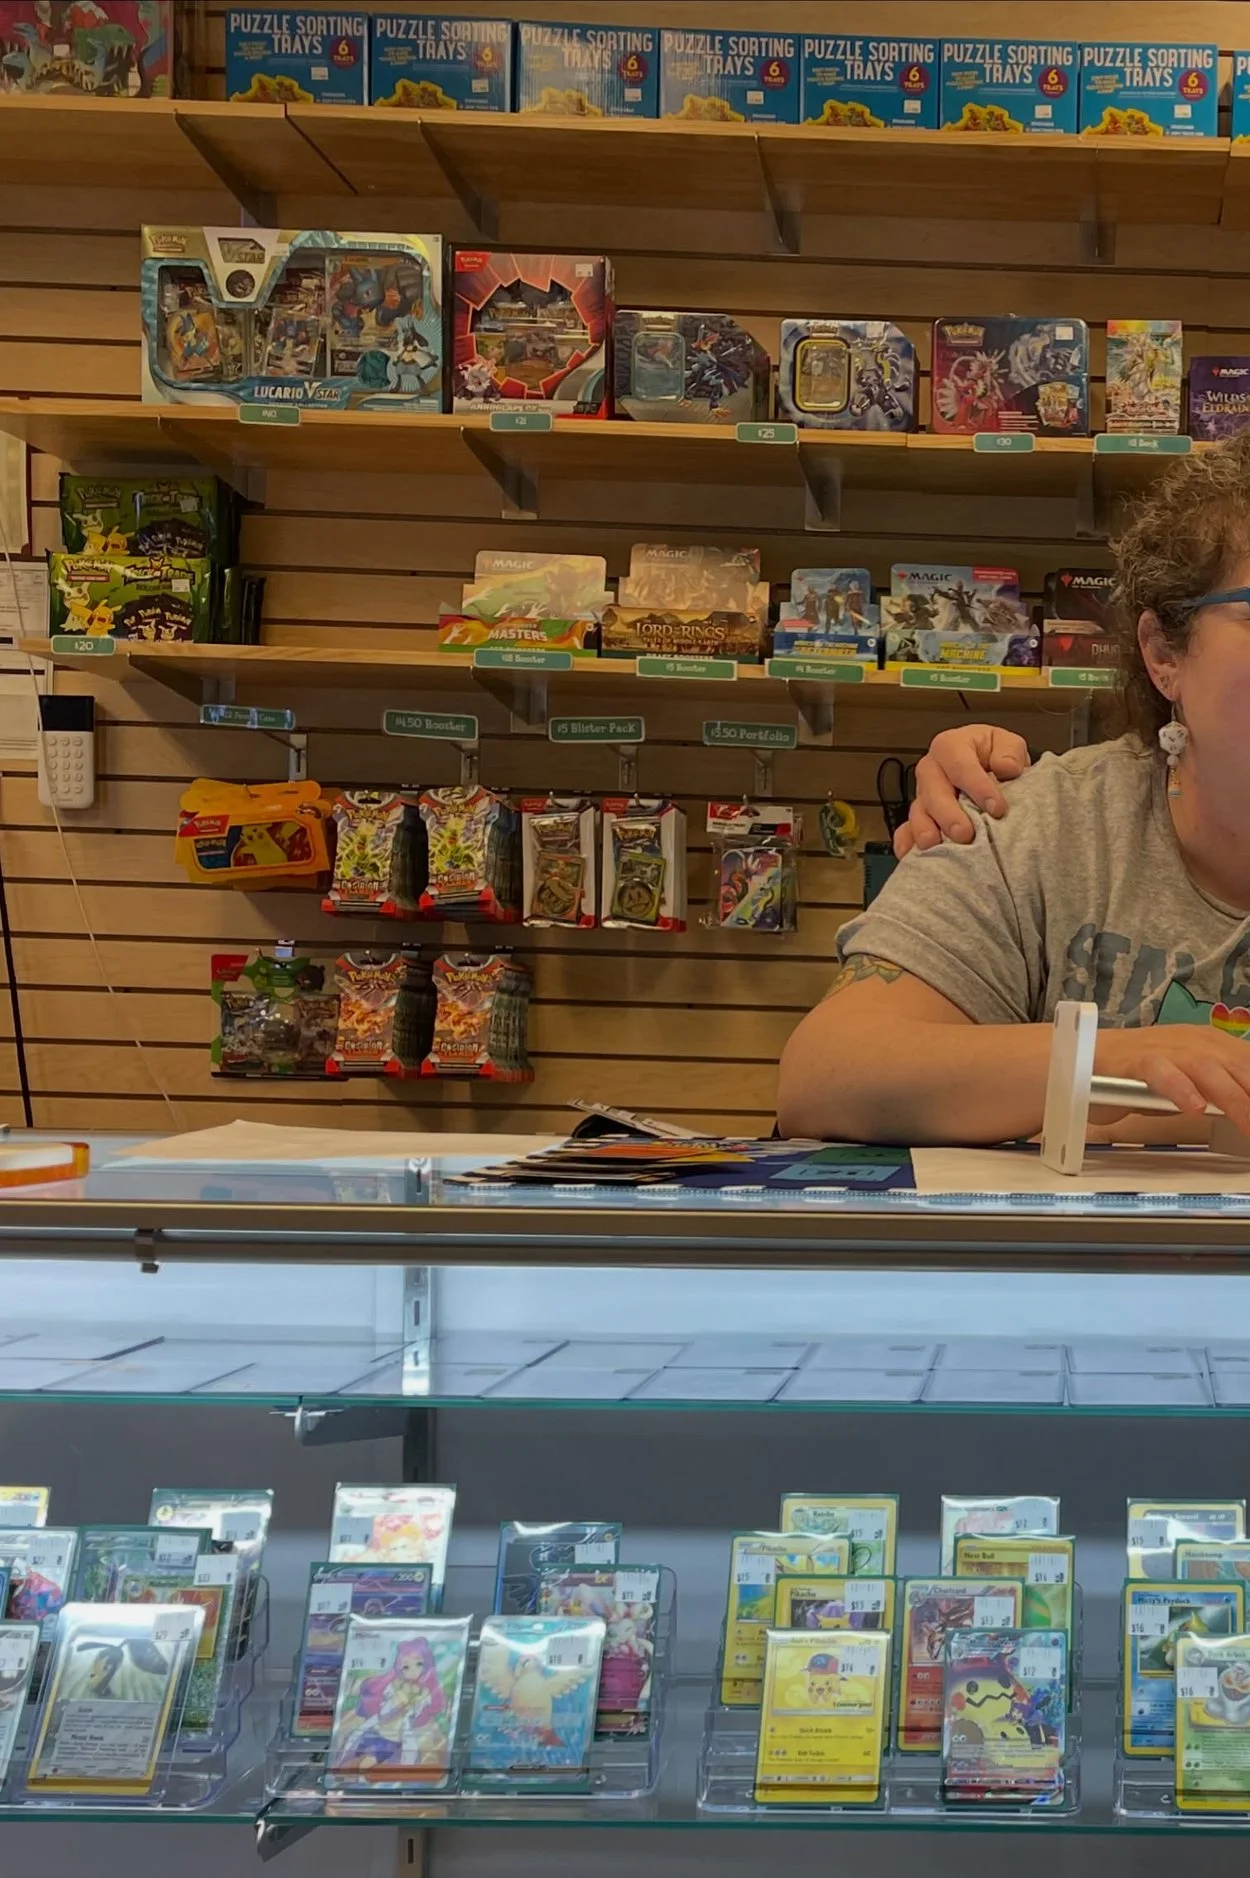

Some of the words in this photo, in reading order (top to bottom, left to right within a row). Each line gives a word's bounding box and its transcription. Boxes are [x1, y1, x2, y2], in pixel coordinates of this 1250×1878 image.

[230, 13, 289, 34] PUZZLE
[296, 16, 364, 36] SORTING
[376, 19, 435, 40] PUZZLE
[441, 22, 508, 42] SORTING
[272, 34, 323, 54] TRAYS
[521, 26, 581, 47] PUZZLE
[587, 30, 653, 51] SORTING
[663, 32, 723, 55] PUZZLE
[729, 37, 795, 58] SORTING
[338, 40, 349, 55] 6
[417, 40, 466, 60] TRAYS
[482, 47, 492, 61] 6
[804, 39, 864, 60] PUZZLE
[868, 43, 934, 63] SORTING
[943, 44, 1003, 64] PUZZLE
[1007, 45, 1073, 65] SORTING
[563, 48, 612, 69] TRAYS
[627, 56, 638, 70] 6
[1084, 47, 1142, 67] PUZZLE
[1148, 49, 1213, 68] SORTING
[705, 55, 754, 75] TRAYS
[769, 61, 780, 76] 6
[844, 60, 894, 81] TRAYS
[909, 67, 920, 81] 6
[984, 64, 1033, 84] TRAYS
[1047, 69, 1059, 84] 6
[1124, 67, 1173, 87] TRAYS
[1188, 73, 1199, 87] 6
[1219, 368, 1249, 377] MAGIC
[254, 385, 303, 399] LUCARIO
[1206, 390, 1246, 402] WILDS
[647, 549, 687, 559] MAGIC
[493, 559, 534, 570] MAGIC
[909, 572, 952, 582] MAGIC
[1072, 577, 1117, 586] MAGIC
[488, 628, 548, 641] MASTERS
[636, 622, 673, 637] LORD
[680, 625, 725, 640] RINGS
[74, 641, 94, 650] $20
[515, 654, 546, 664] Booster
[676, 664, 707, 673] Booster
[806, 665, 836, 675] Booster
[940, 674, 971, 683] Booster
[425, 721, 467, 732] Booster
[571, 723, 606, 734] Blister
[609, 723, 636, 733] Pack
[739, 728, 790, 741] Portfolio
[790, 1590, 816, 1598] Pikachu
